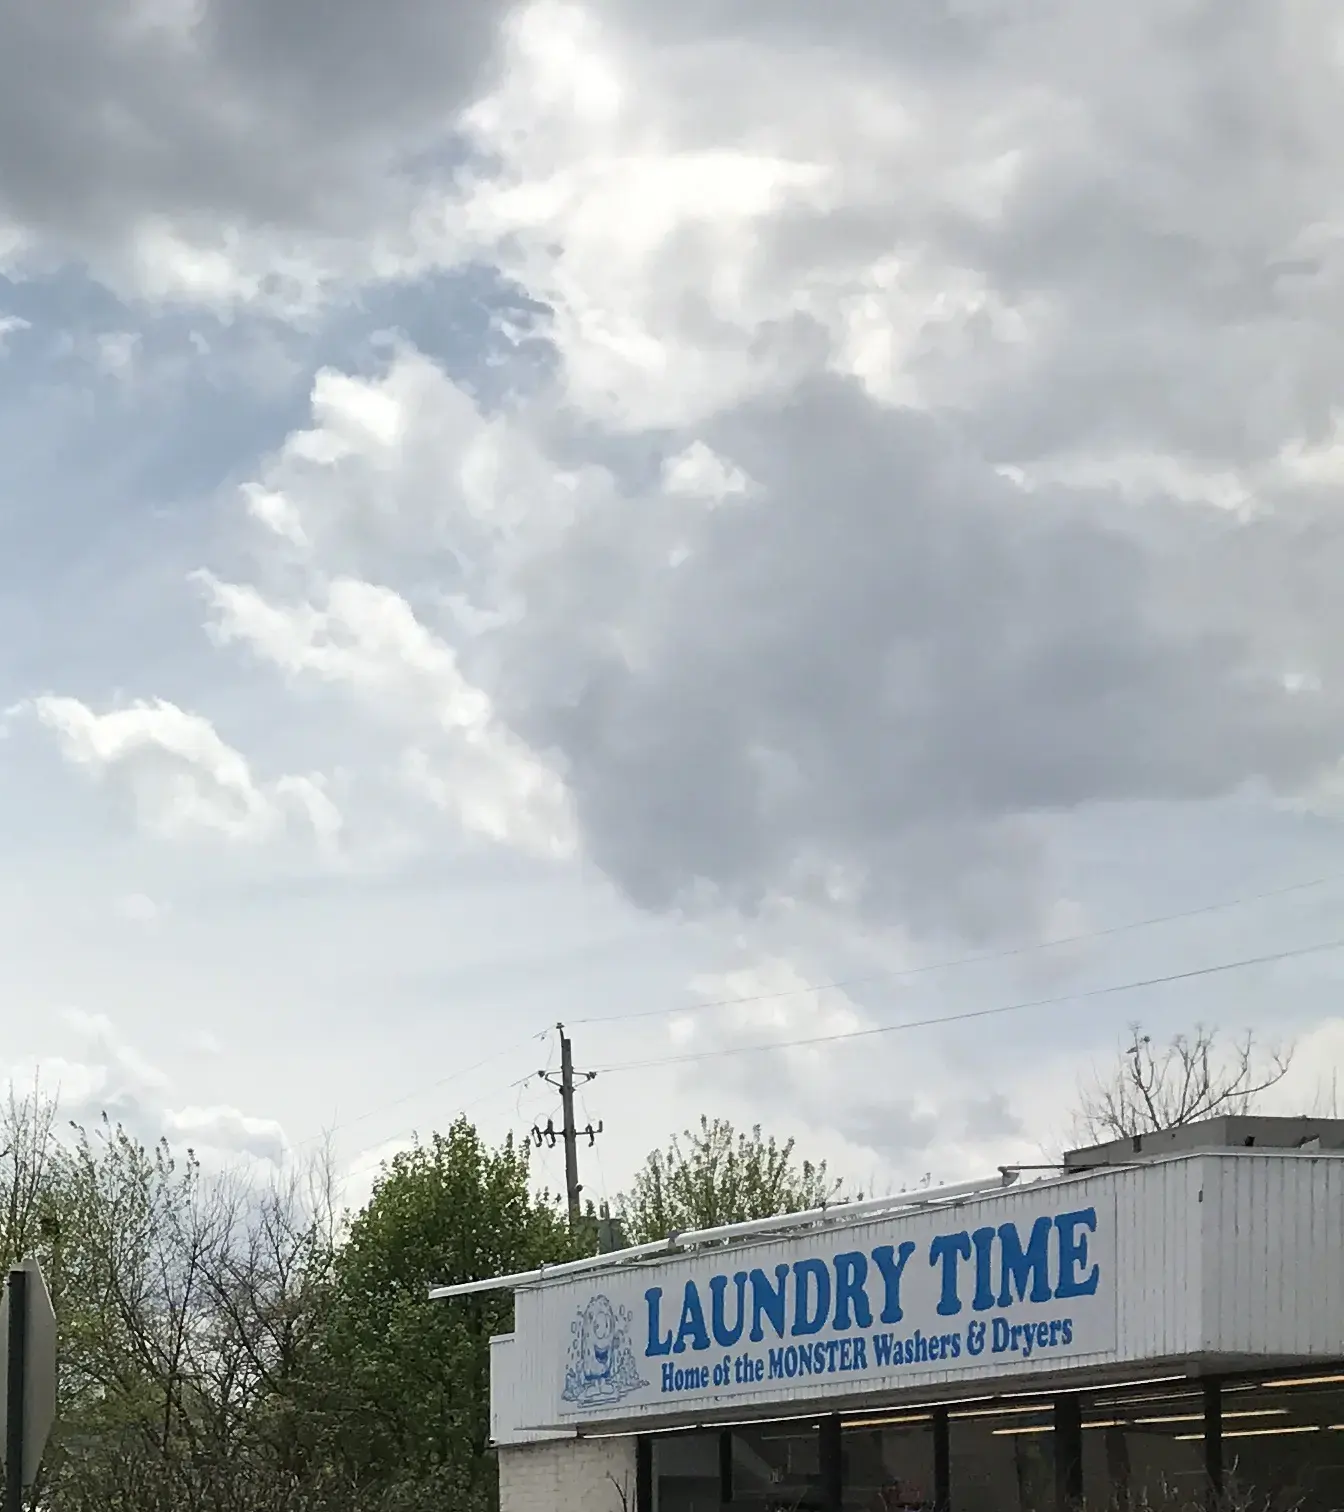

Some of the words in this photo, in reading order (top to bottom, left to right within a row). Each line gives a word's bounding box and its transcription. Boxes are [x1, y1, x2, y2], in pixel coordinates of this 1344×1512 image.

[644, 1240, 916, 1357] LAUNDRY
[929, 1206, 1100, 1317] TIME
[660, 1356, 710, 1394] Home
[712, 1352, 732, 1386] of
[735, 1350, 764, 1384] the
[767, 1338, 868, 1381] MONSTER
[873, 1330, 961, 1369] Washers
[966, 1320, 986, 1356] &
[990, 1317, 1073, 1358] Dryers
